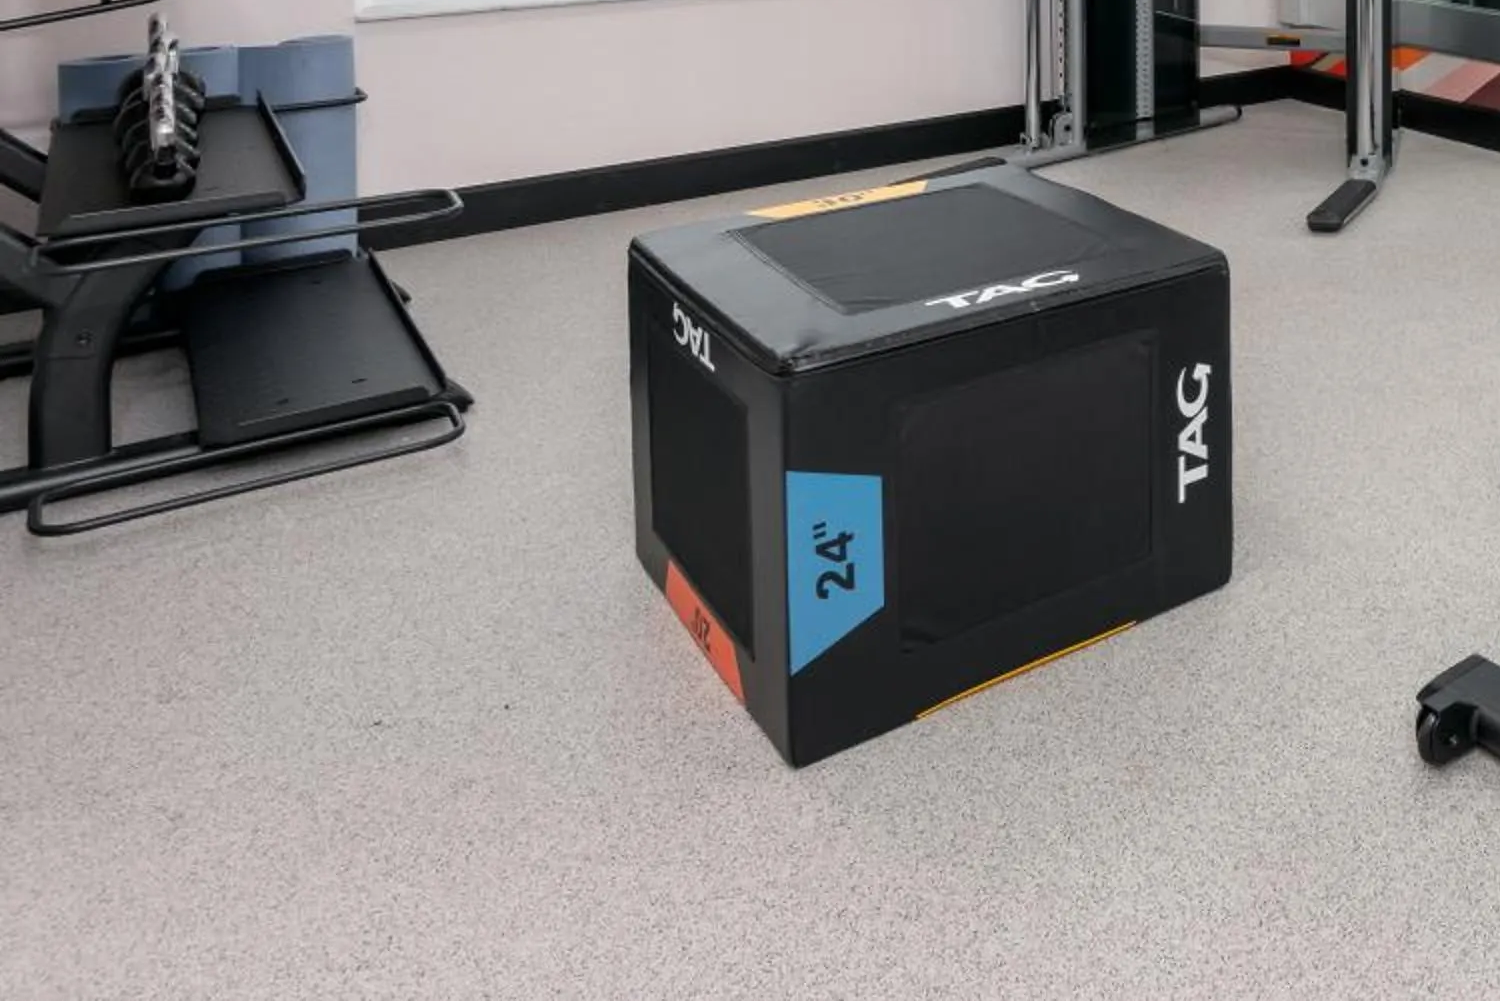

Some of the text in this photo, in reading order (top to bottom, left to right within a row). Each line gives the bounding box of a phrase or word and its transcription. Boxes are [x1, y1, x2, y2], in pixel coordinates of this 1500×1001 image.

[926, 270, 1080, 309] TAG
[673, 302, 715, 372] TAG
[1177, 363, 1212, 503] TAG
[813, 521, 856, 600] 24"
